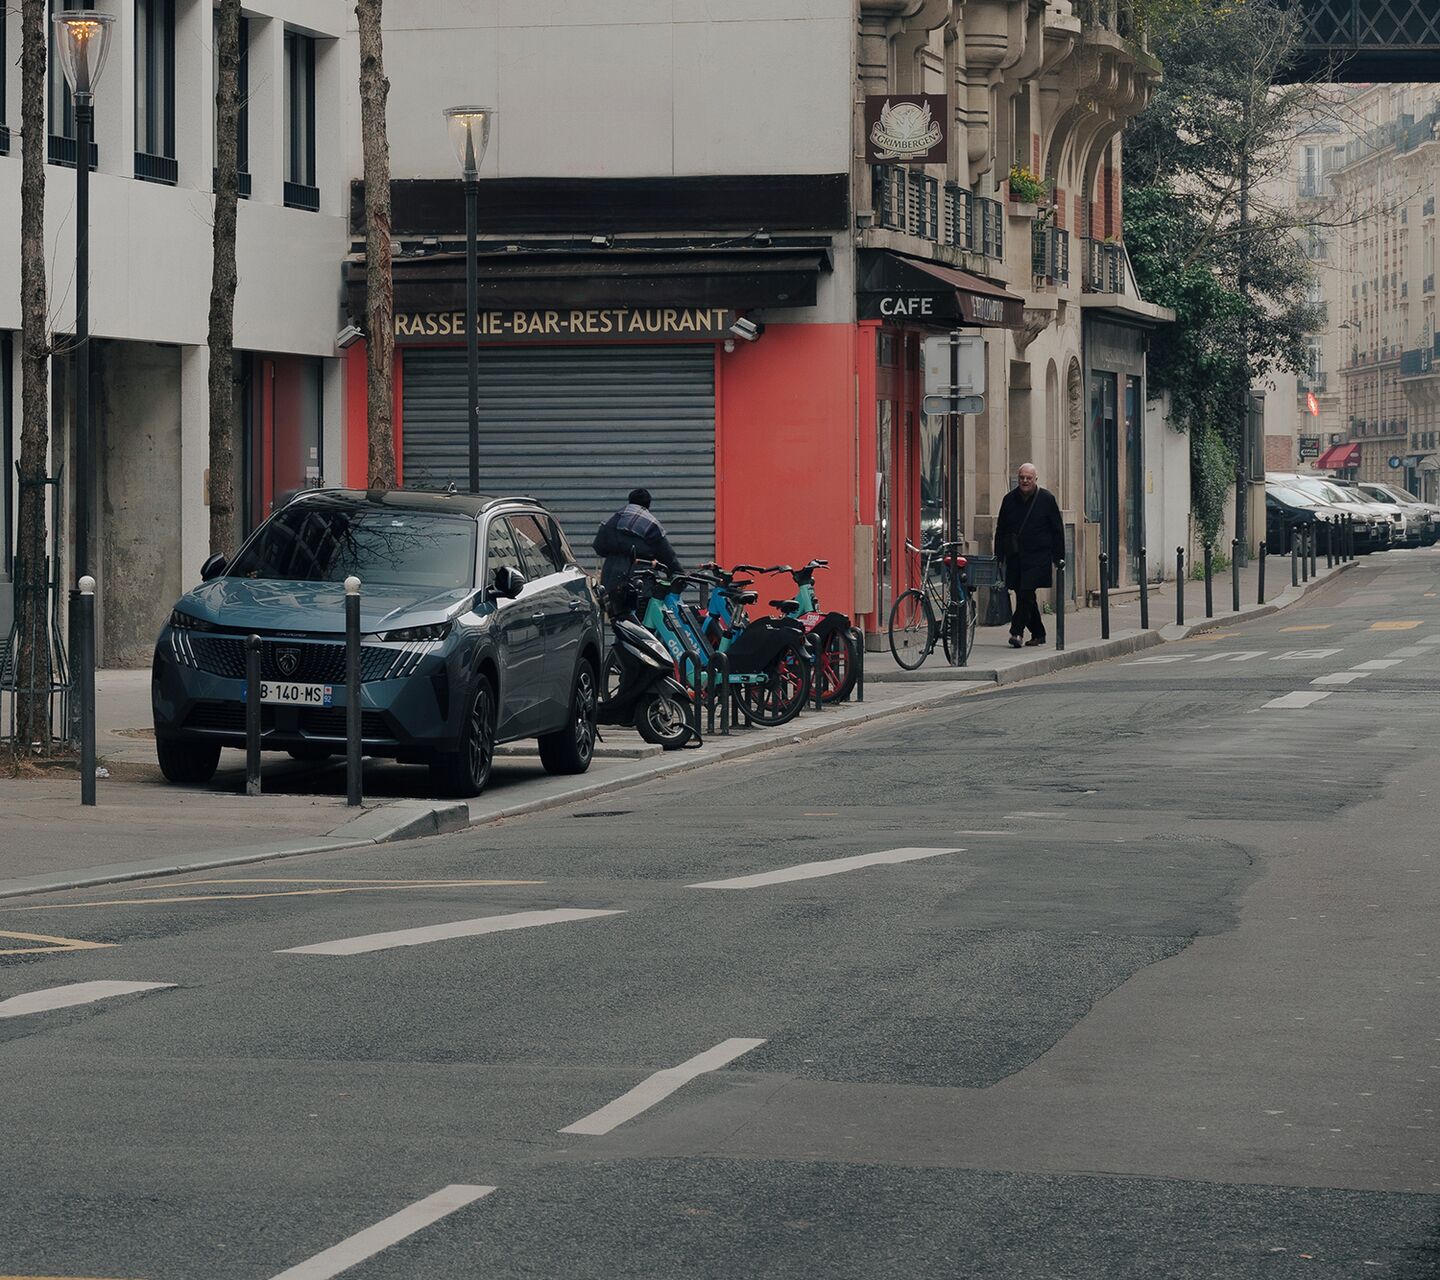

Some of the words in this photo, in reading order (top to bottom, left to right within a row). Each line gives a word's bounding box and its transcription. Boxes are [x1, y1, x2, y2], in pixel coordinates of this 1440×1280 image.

[877, 133, 936, 149] GRIMBERGEN
[880, 297, 933, 315] CAFE
[395, 308, 729, 337] RASSEIE-BAR-RESTAURANT
[260, 684, 322, 702] B-140-MS
